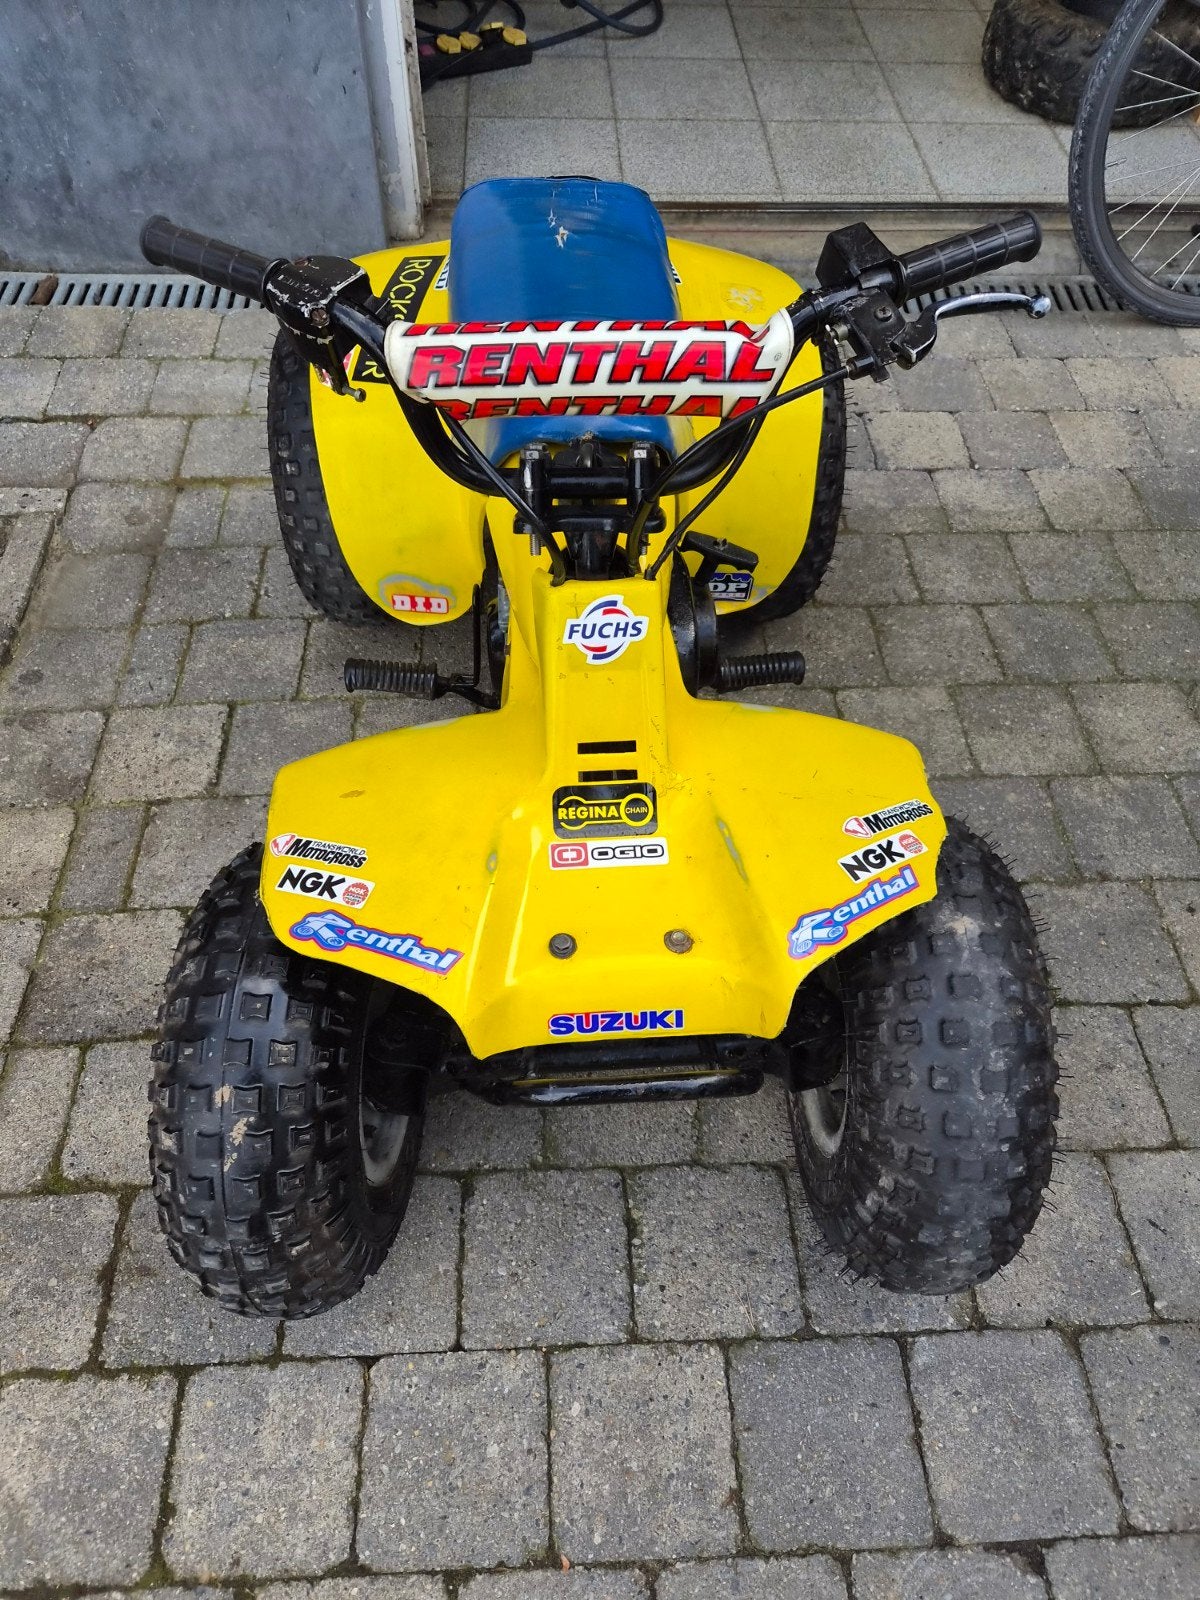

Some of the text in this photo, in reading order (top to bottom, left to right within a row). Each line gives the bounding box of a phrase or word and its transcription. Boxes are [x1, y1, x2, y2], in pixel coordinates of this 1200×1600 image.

[407, 340, 776, 388] RENTHAL
[708, 582, 749, 593] DP
[568, 621, 643, 639] FUCHS
[558, 805, 648, 820] REGINA CHAIN
[863, 804, 933, 833] MOTOCROSS
[285, 838, 367, 868] MOTOCROSS
[312, 841, 366, 855] TRANSWORLD
[591, 844, 665, 861] OGIO
[840, 839, 905, 882] NGK
[277, 866, 346, 900] NGK
[791, 868, 916, 954] Renthal
[292, 912, 458, 969] Renthal
[549, 1009, 684, 1036] SUZUKI
